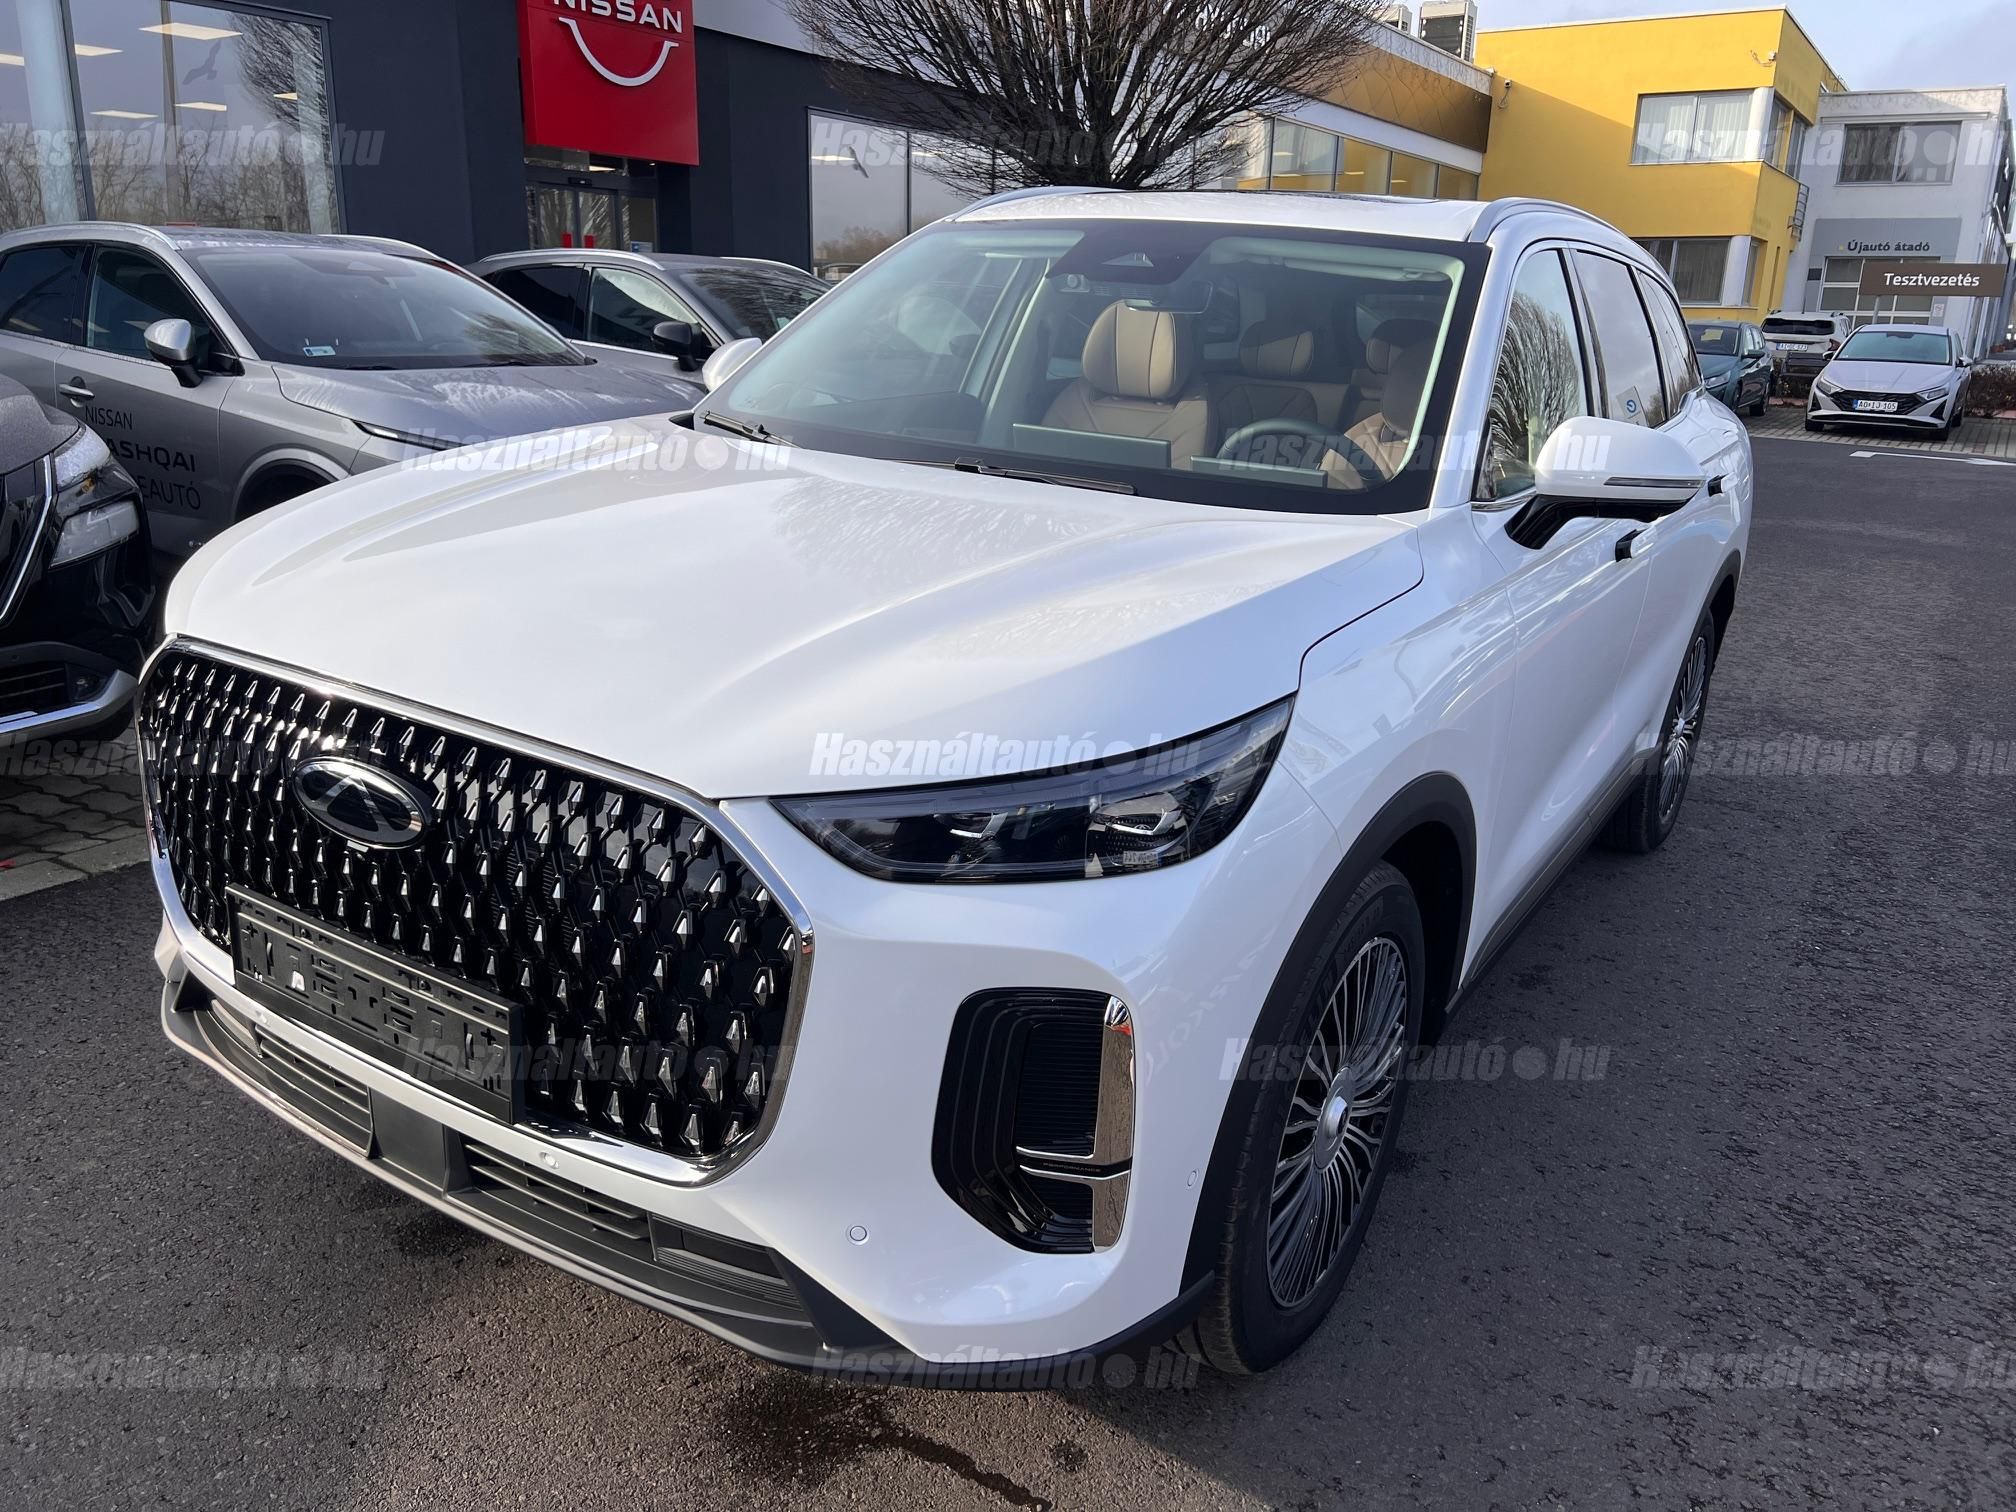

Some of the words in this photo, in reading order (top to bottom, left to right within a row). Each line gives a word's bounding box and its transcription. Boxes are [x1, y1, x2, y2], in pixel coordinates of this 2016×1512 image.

[1847, 239, 1890, 254] Újautó
[1894, 241, 1930, 252] átadó
[1883, 273, 1980, 287] Tesztvezetés
[85, 405, 133, 430] NISSAN
[107, 438, 195, 472] ASHQAI
